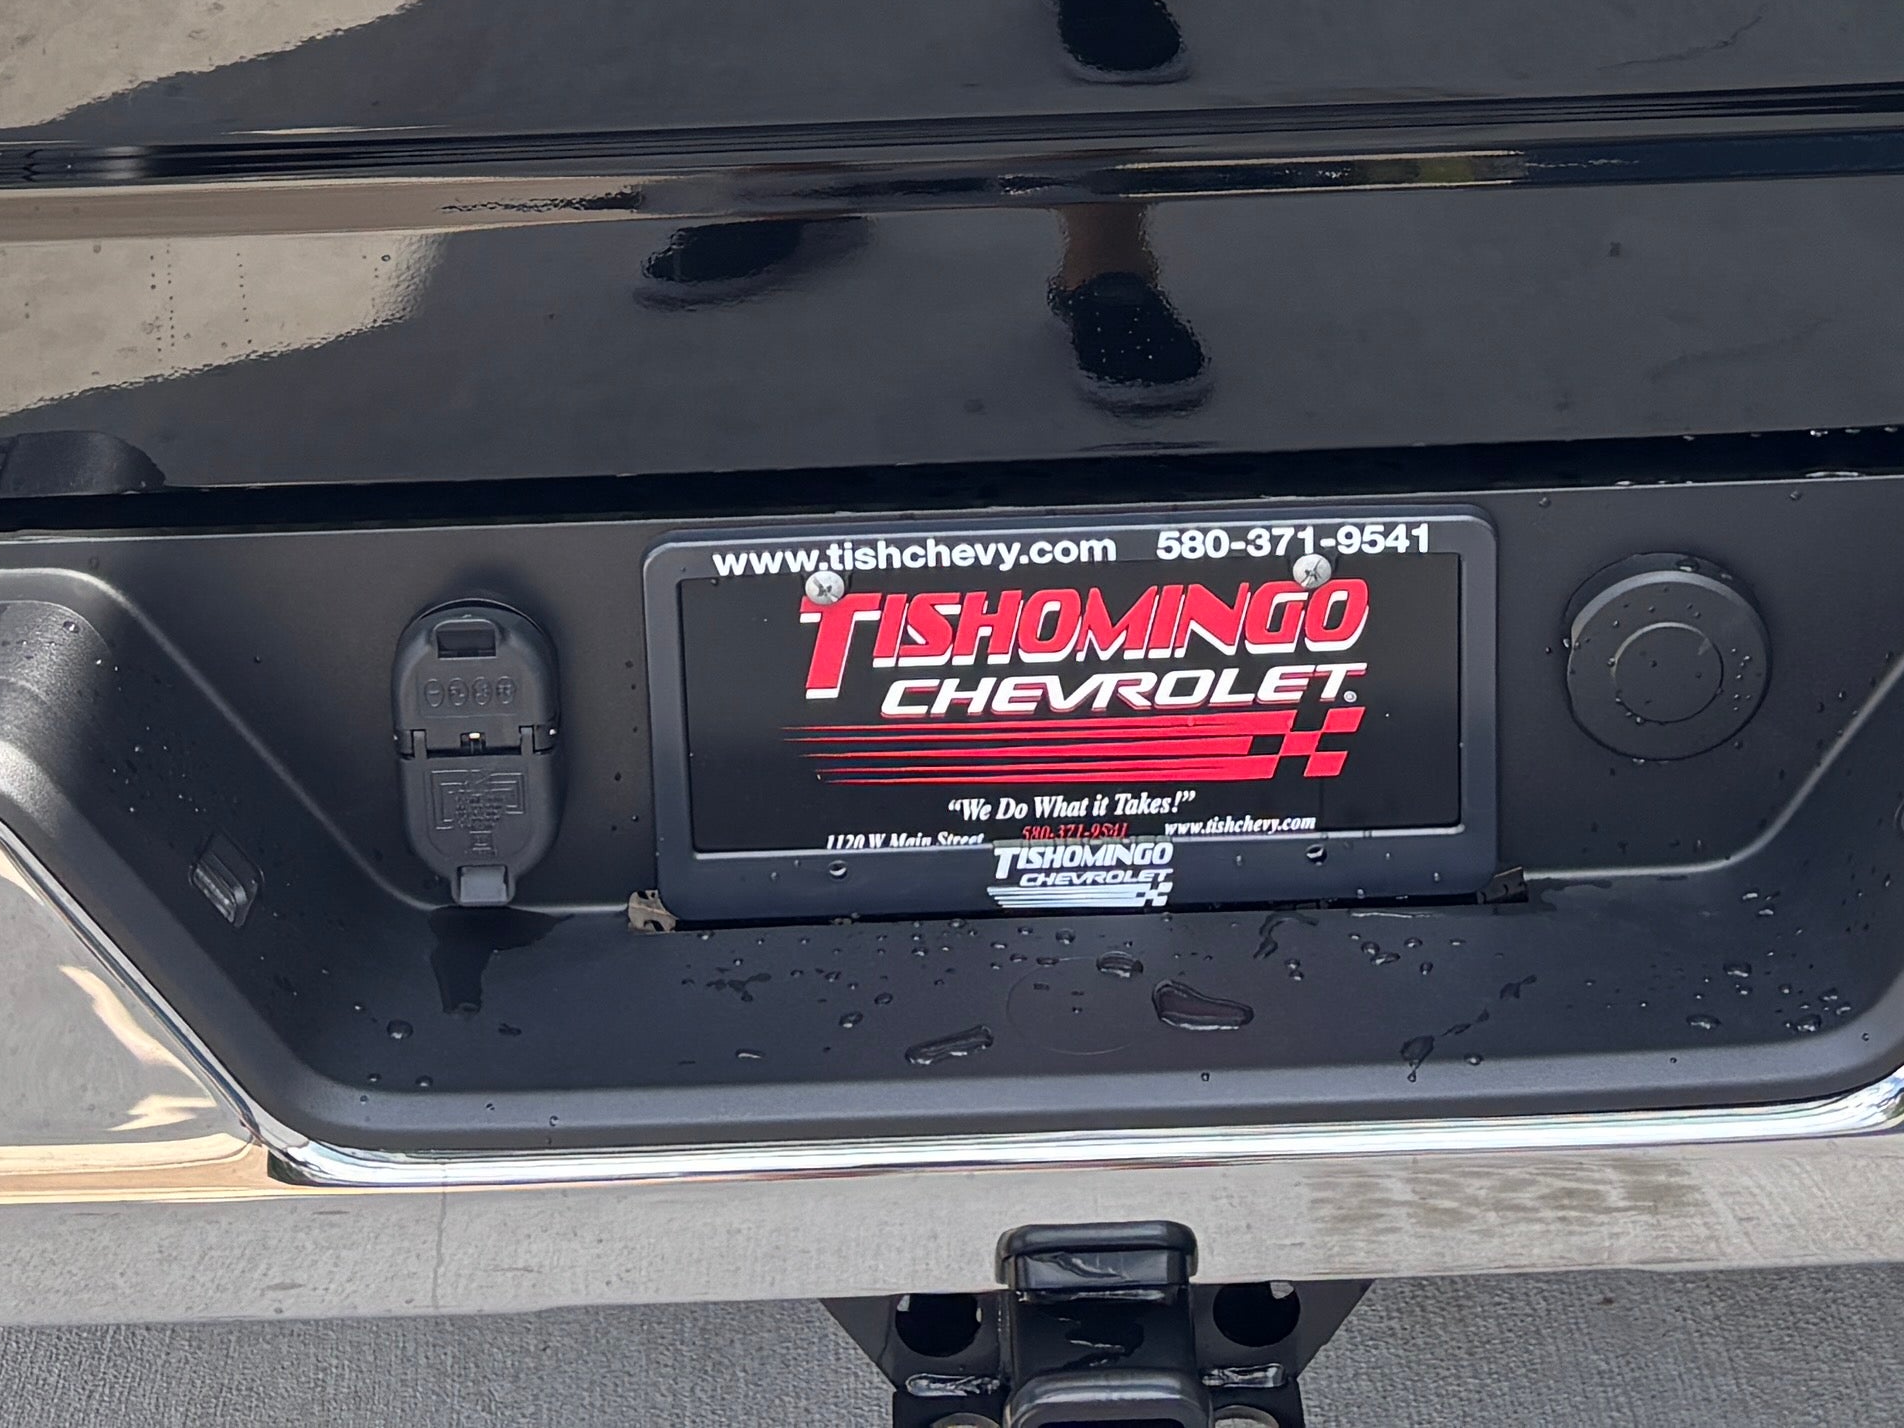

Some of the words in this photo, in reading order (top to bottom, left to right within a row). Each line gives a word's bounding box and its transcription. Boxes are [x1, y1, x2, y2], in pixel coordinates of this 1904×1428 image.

[712, 536, 1117, 576] www.tishchevy.com
[1156, 523, 1430, 560] 580-371-9541
[799, 578, 1369, 699] TISHOMINGO
[880, 663, 1368, 717] CHEVROLET
[995, 797, 1029, 820] Do
[1033, 794, 1090, 819] What
[1092, 793, 1107, 817] it
[868, 833, 886, 849] W
[1164, 815, 1317, 835] www.tishchevy.com
[993, 841, 1174, 880] TISHOMINGO
[1019, 868, 1174, 887] CHEVROLET
